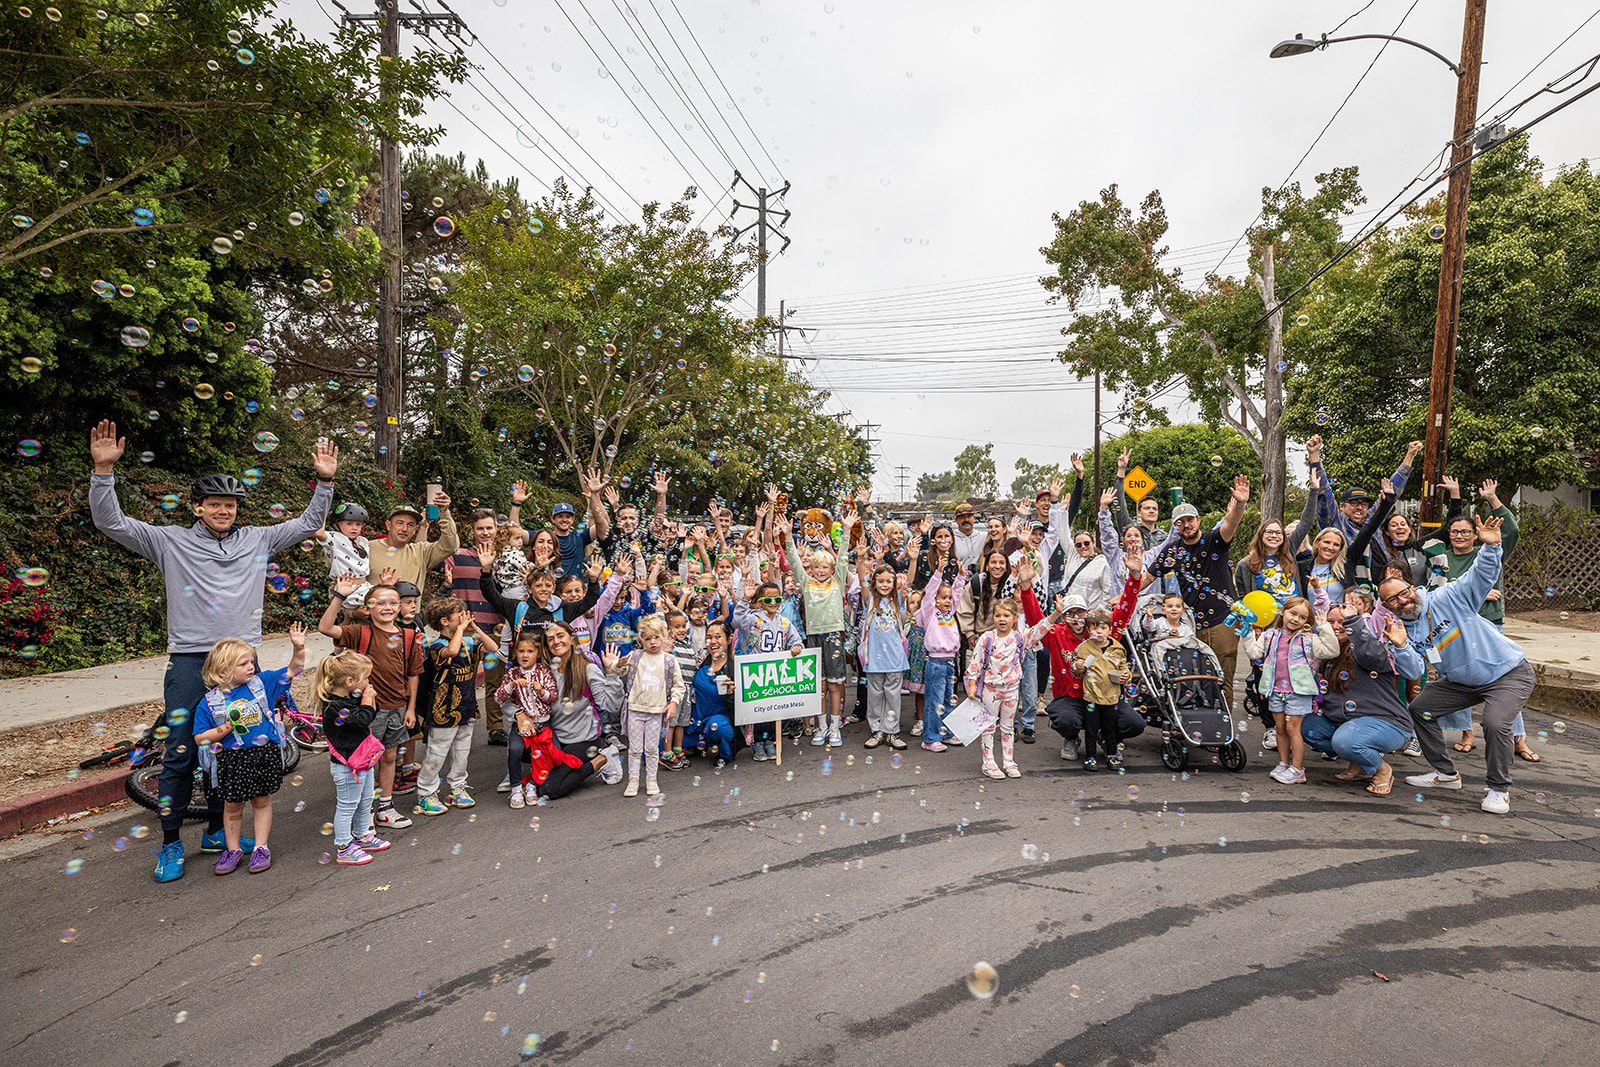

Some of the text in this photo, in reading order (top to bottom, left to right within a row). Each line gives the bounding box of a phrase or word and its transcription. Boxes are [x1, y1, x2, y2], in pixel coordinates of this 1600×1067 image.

[1128, 480, 1147, 489] END
[743, 658, 815, 689] WALK
[747, 683, 815, 699] TO SCHOOL DAY
